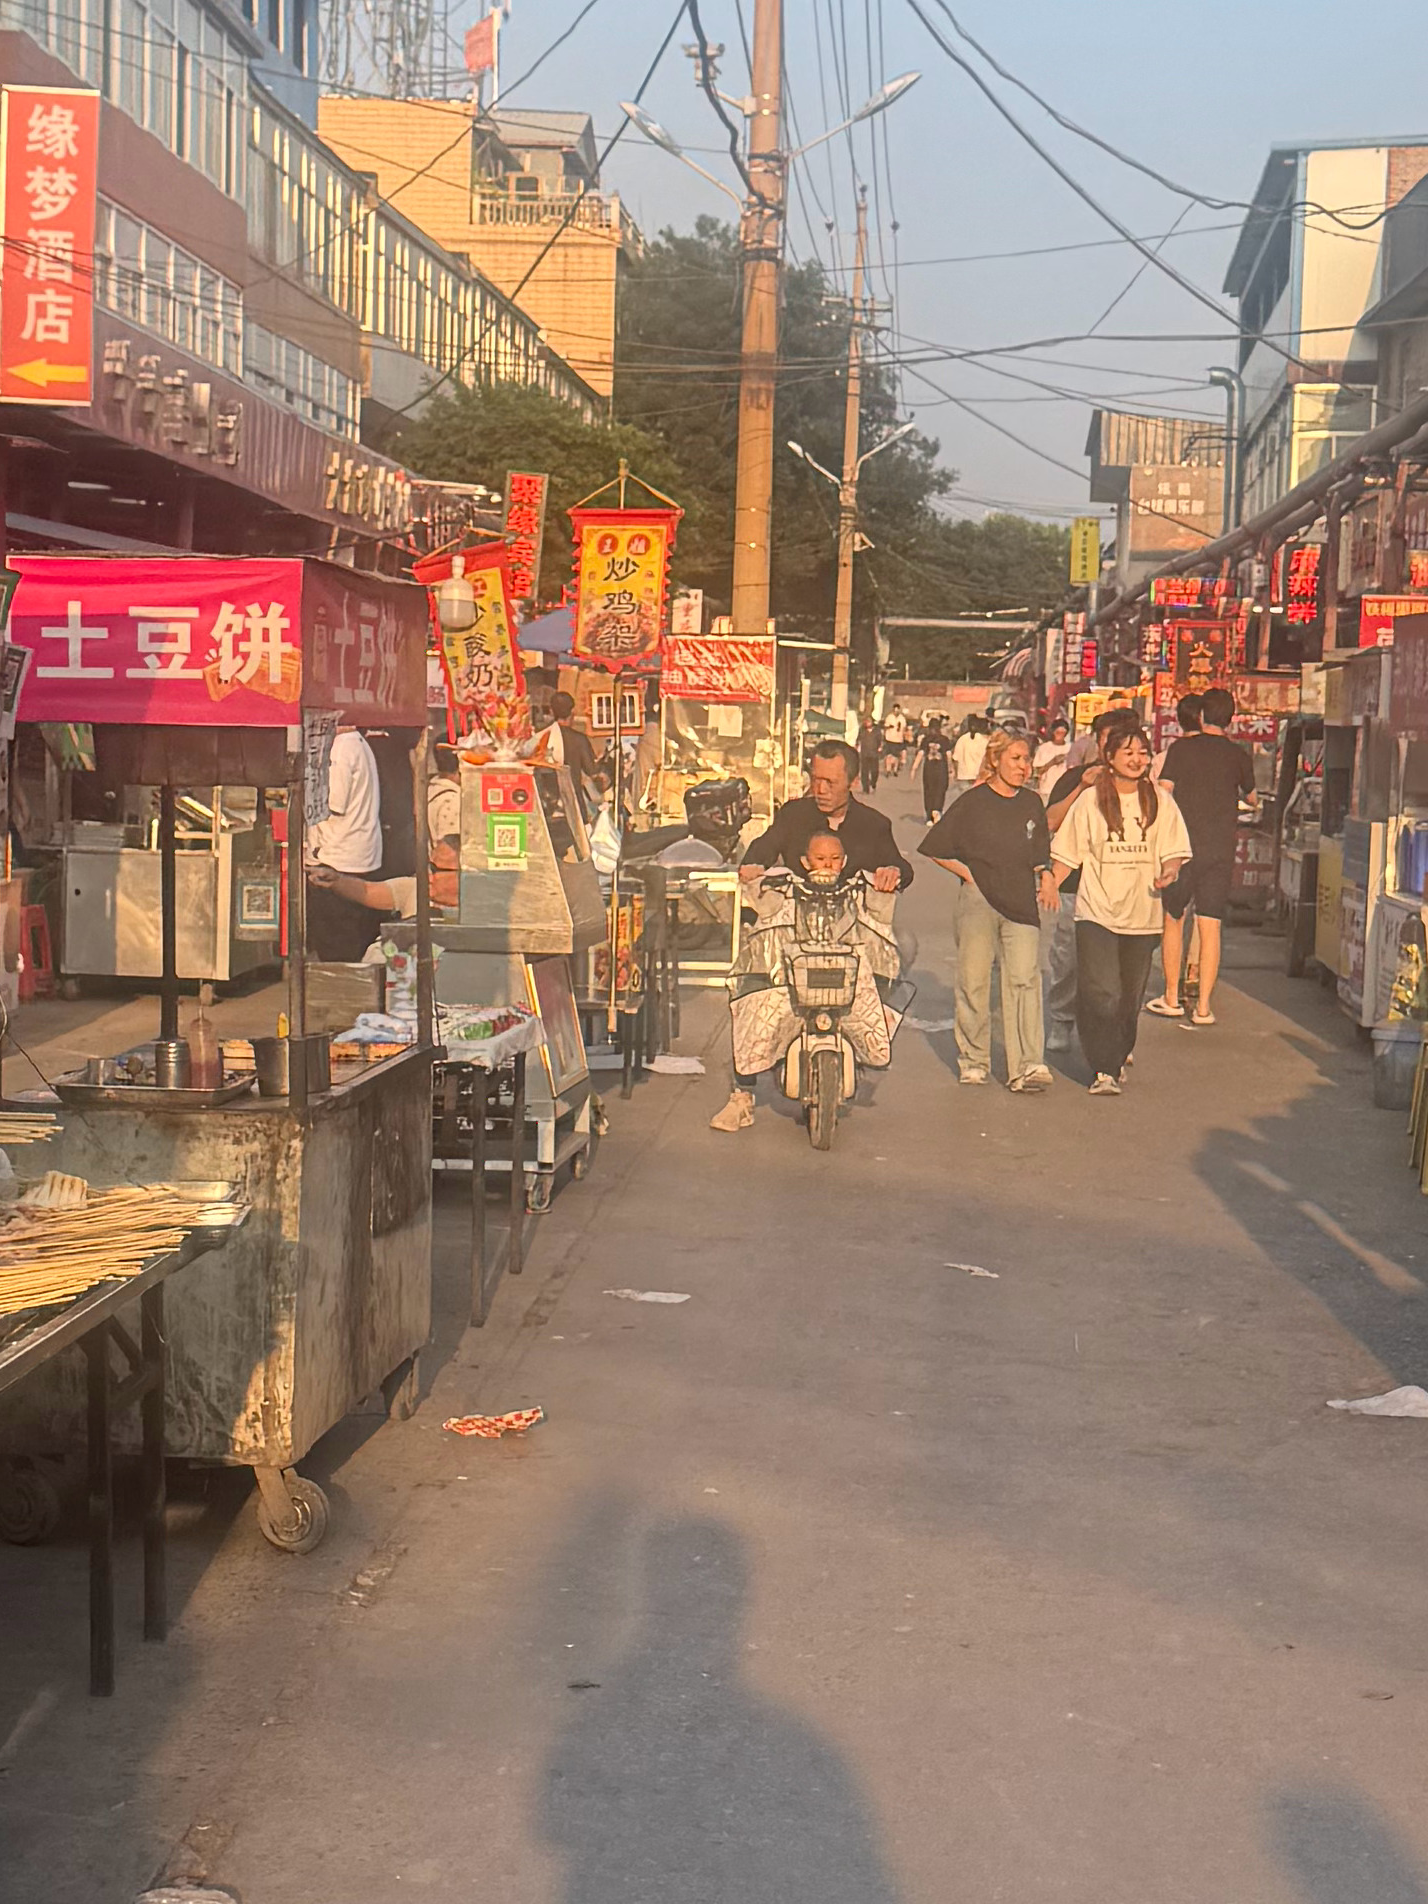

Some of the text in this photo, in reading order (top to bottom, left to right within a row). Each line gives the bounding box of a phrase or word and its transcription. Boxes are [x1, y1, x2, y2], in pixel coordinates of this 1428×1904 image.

[20, 103, 80, 345] 缘梦酒店
[36, 599, 295, 684] 土豆饼
[598, 556, 642, 650] 炒鸡架
